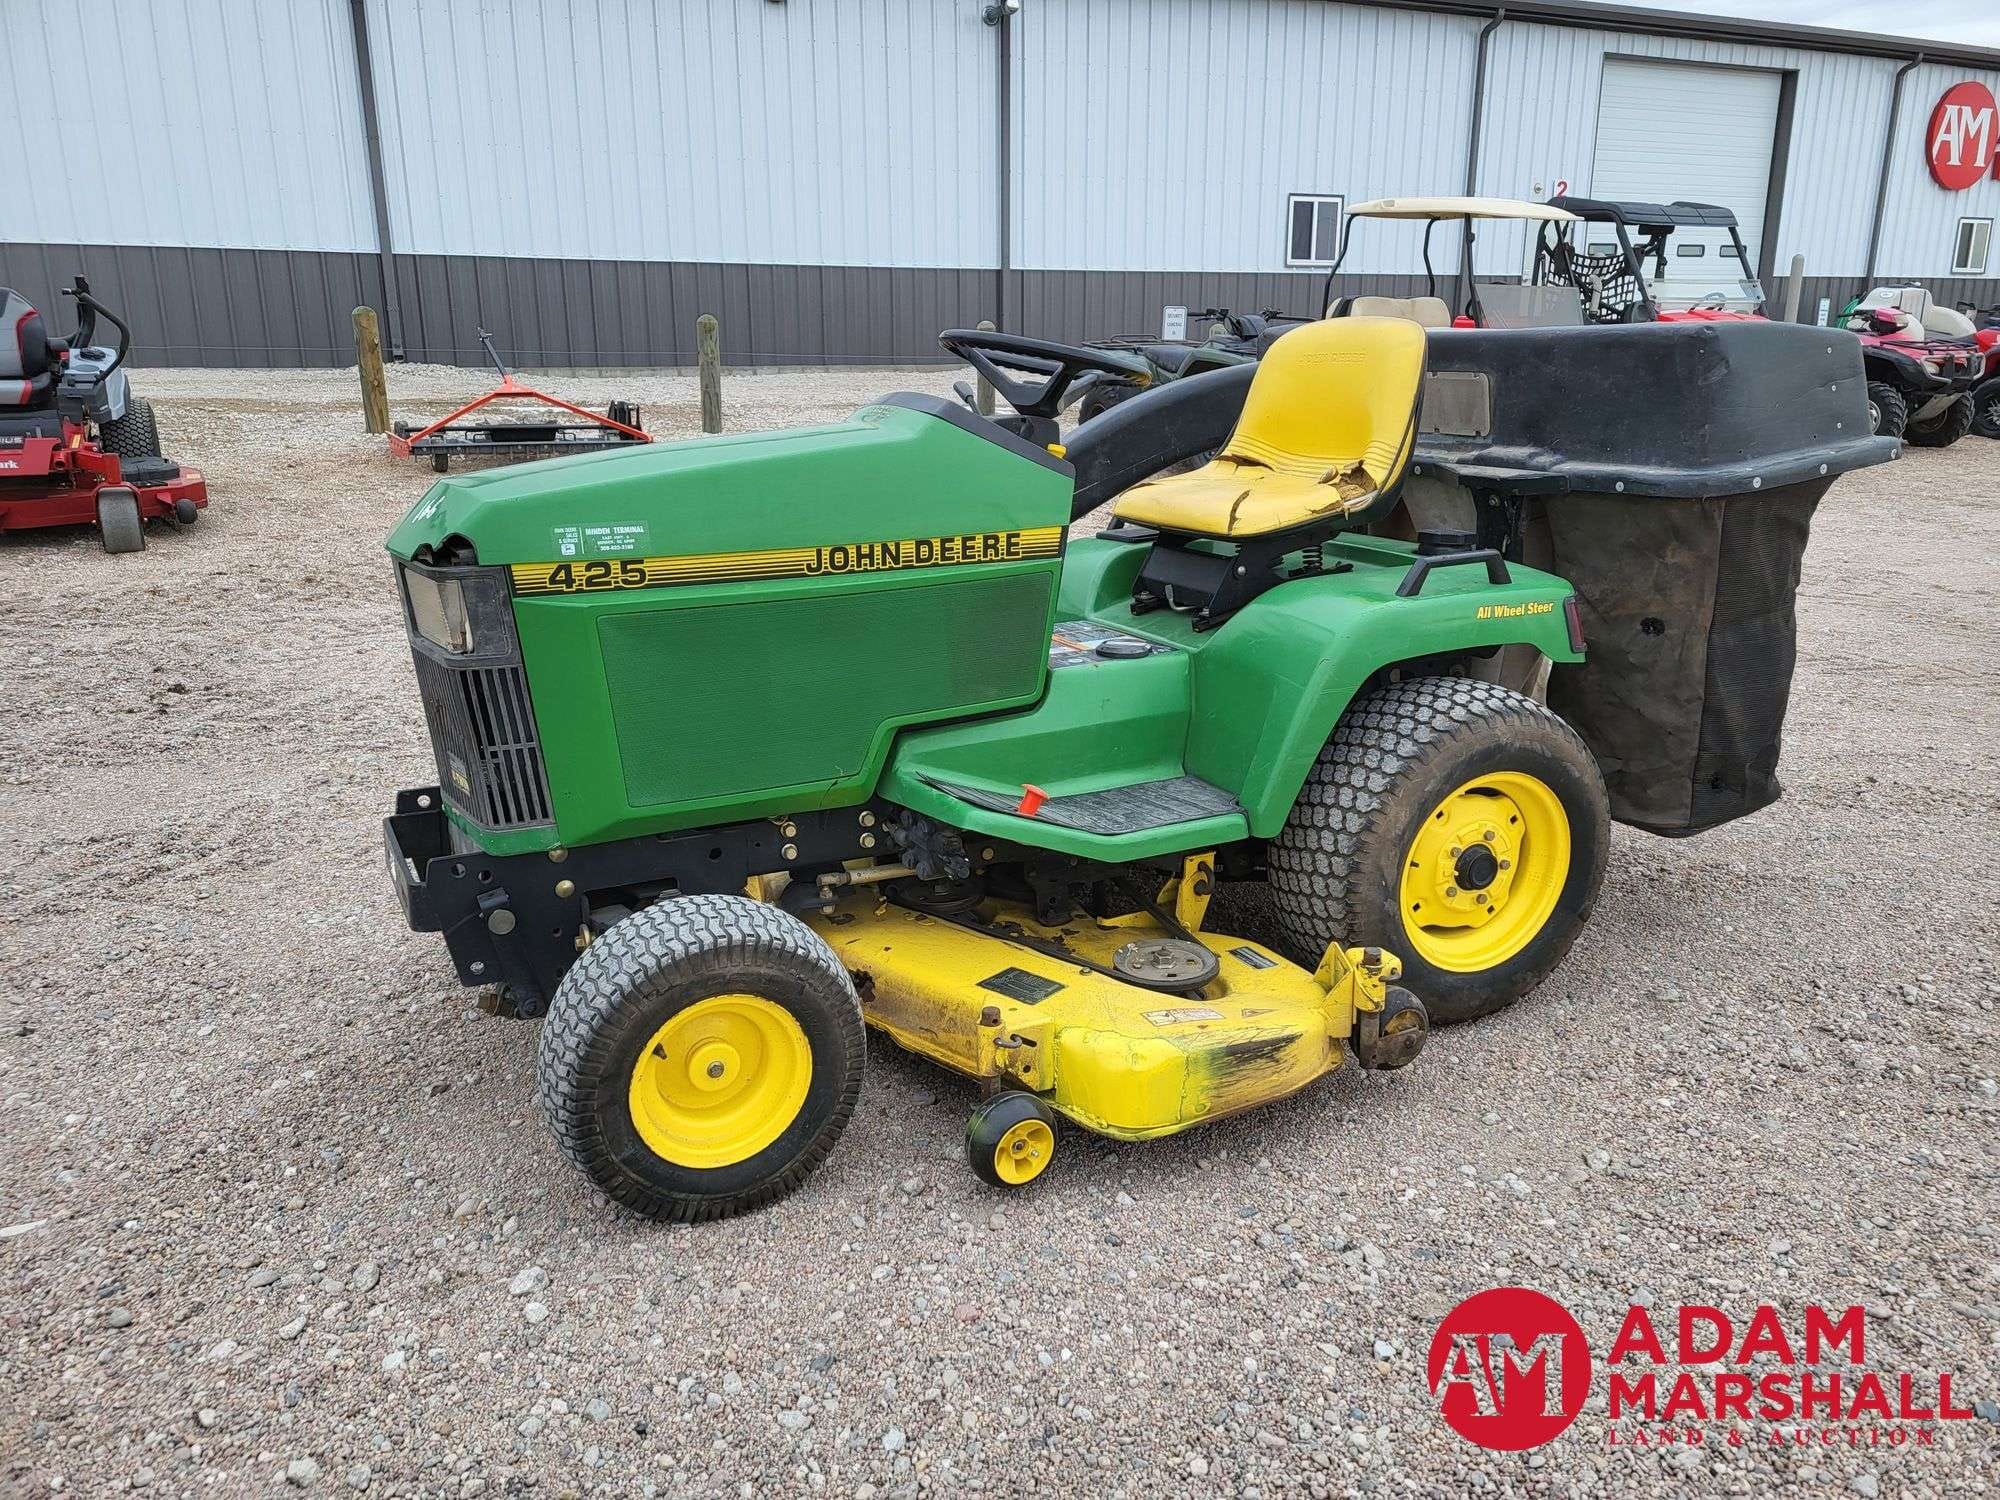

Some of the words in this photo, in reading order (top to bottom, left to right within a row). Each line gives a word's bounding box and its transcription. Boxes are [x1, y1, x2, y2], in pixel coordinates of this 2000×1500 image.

[1932, 104, 1993, 167] AM
[1557, 181, 1568, 199] 2
[613, 525, 644, 534] TERMINAL
[804, 544, 901, 574] JOHN
[914, 532, 1021, 565] DEERE
[547, 559, 647, 590] 425
[1477, 606, 1491, 619] All
[1494, 604, 1525, 618] Wheel
[1527, 602, 1554, 614] Steer
